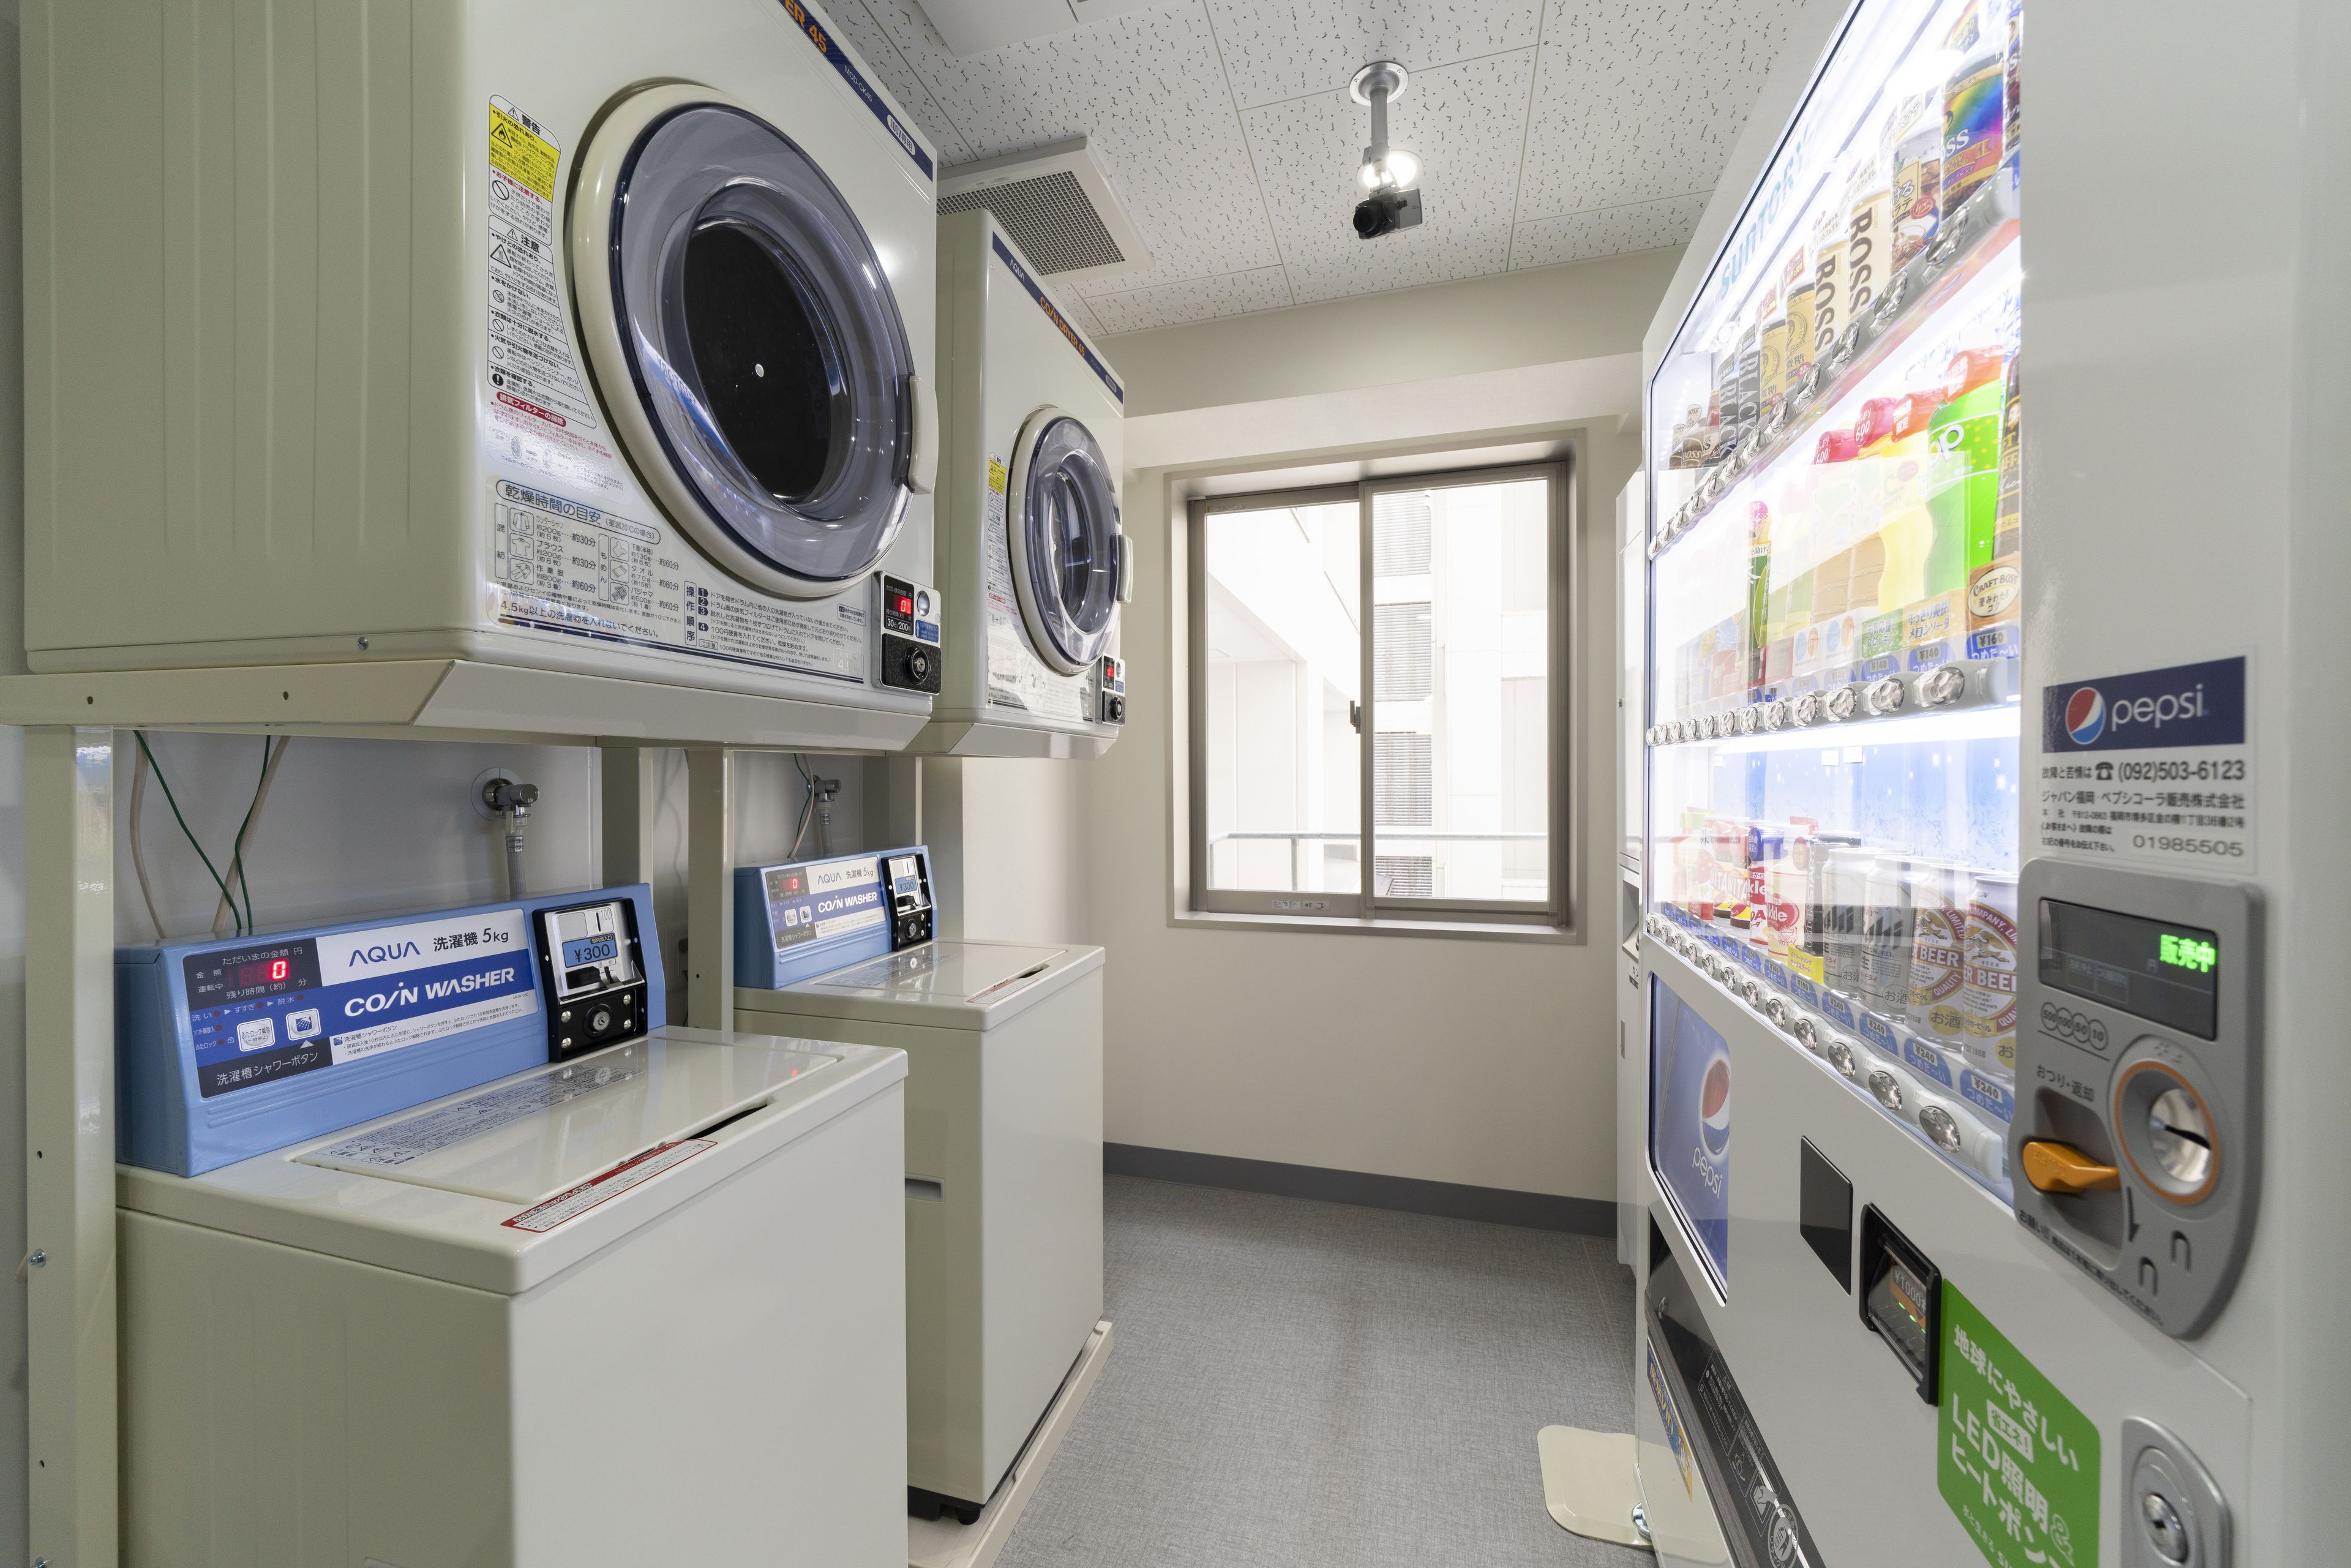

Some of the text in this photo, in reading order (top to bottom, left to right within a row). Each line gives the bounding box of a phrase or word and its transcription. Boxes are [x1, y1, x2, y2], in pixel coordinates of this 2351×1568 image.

[809, 24, 827, 53] 45
[844, 66, 872, 102] MCD-CK45
[496, 111, 536, 143] 引火の恐れあり。
[521, 113, 541, 135] 警告
[890, 119, 912, 152] 100V専用
[496, 170, 542, 204] お子様に注意する。
[511, 188, 550, 217] 子供だけで使わせ
[511, 195, 550, 223] たり幼児の手の届
[490, 202, 547, 240] けがをする恐れがあります。
[511, 201, 550, 228] くところで使わな
[495, 234, 540, 263] やけどの恐れあり。
[520, 234, 539, 253] 注意
[506, 247, 553, 278] 運転が終わってから衣
[1850, 207, 1873, 314] BOSS
[495, 276, 531, 300] 水をかけない。
[1010, 259, 1024, 282] AQUA
[1059, 319, 1078, 348] DRYER
[1078, 343, 1085, 357] 45
[1815, 255, 1838, 353] BOSS
[495, 310, 551, 343] 衣類は十分に脱水する。
[507, 307, 553, 334] 火災の恐れがあります。
[495, 335, 561, 370] 火気や引火物を近づけない。
[506, 324, 569, 359] しずくのたれるような衣類を入れな
[494, 366, 534, 388] 衣類を確認する。
[506, 361, 553, 385] 火災の原因になります。
[506, 384, 552, 408] 感電の恐れがあります。
[499, 392, 563, 426] 排気フィルターの掃除
[1720, 381, 1737, 459] BLACK
[1856, 421, 1870, 441] 600
[505, 484, 601, 525] 乾燥時間の目安
[536, 540, 564, 553] ブラウス
[572, 533, 596, 546] 約30分
[572, 557, 596, 571] 約30分
[631, 565, 653, 576] タオル
[659, 558, 680, 571] 約60分
[572, 580, 596, 593] 約60分
[659, 579, 680, 590] 約60分
[1973, 574, 2018, 597] CRAFT BOSS
[659, 600, 680, 611] 約60分
[686, 586, 696, 641] 操作順序
[901, 601, 906, 612] 0
[887, 618, 911, 632] 30分/200円
[1910, 617, 1950, 640] メロンソーダ
[711, 626, 808, 652] 100円硬貨を入れてください。乾燥を始めます。
[1979, 632, 2004, 647] ¥160
[1919, 648, 1939, 660] ¥140
[1871, 661, 1887, 671] ¥140
[2112, 683, 2203, 732] pepsi
[2119, 760, 2245, 782] (092)503-6123
[2132, 835, 2244, 857] 01985505
[792, 879, 797, 888] 0
[817, 868, 874, 885] AQUA 洗濯機 5kg
[900, 882, 914, 891] ¥300
[818, 895, 843, 913] COIN
[845, 891, 877, 907] WASHER
[601, 909, 611, 920] 100
[1946, 909, 1964, 939] LIMITED
[222, 948, 289, 966] ただいまの金額
[348, 928, 509, 967] AQUA 洗濯機 5kg
[574, 944, 610, 962] ¥300
[1920, 946, 1959, 967] BEER
[2160, 933, 2216, 973] 販売中
[272, 961, 285, 980] 0
[1769, 964, 1779, 974] ¥140
[198, 983, 223, 992] 運転中
[344, 967, 515, 1017] COIN WASHER
[1797, 977, 1809, 990] ¥190
[1933, 972, 1961, 996] QUALITY
[234, 1003, 255, 1013] すすぎ
[1830, 995, 1843, 1012] ¥240
[1869, 1018, 1885, 1035] ¥240
[1931, 1011, 1961, 1029] お酒
[241, 1026, 271, 1040] ふたロック解除
[343, 1025, 397, 1043] 洗濯槽シャワーボタン
[2092, 1028, 2104, 1041] 10
[195, 1041, 216, 1051] ふたロック
[1914, 1043, 1935, 1065] ¥240
[217, 1052, 318, 1086] 洗濯槽シャワーボタン
[1974, 1075, 1999, 1100] ¥240
[1692, 1144, 1722, 1199] pepsi
[1954, 1324, 2079, 1472] 地球にやさしい
[1953, 1392, 2048, 1534] LED照明
[1952, 1432, 2060, 1568] ヒートポン
